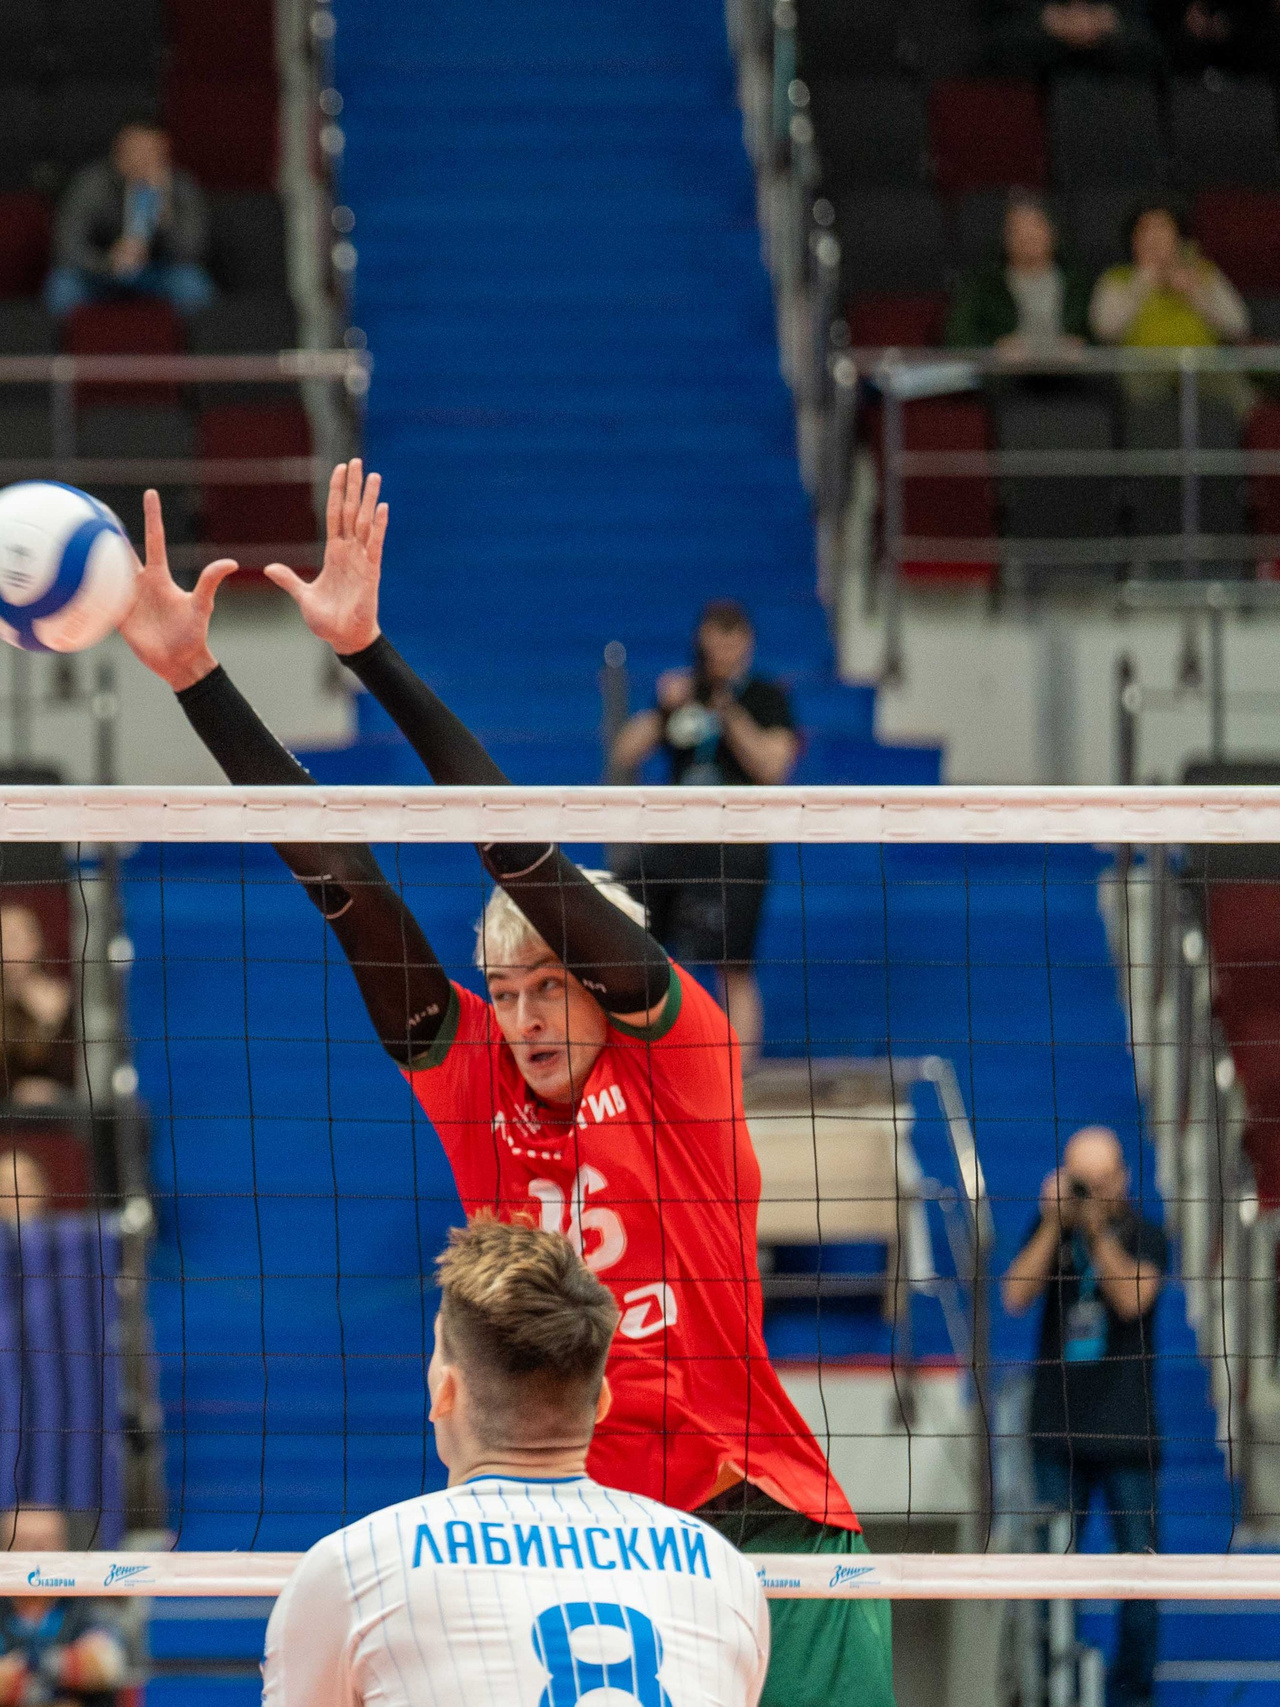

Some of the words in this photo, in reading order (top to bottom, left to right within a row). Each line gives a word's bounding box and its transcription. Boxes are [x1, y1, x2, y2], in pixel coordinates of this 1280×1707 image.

[527, 1162, 628, 1273] 16
[412, 1518, 711, 1579] ЛАБИНСКИЙ
[531, 1602, 674, 1707] 8
